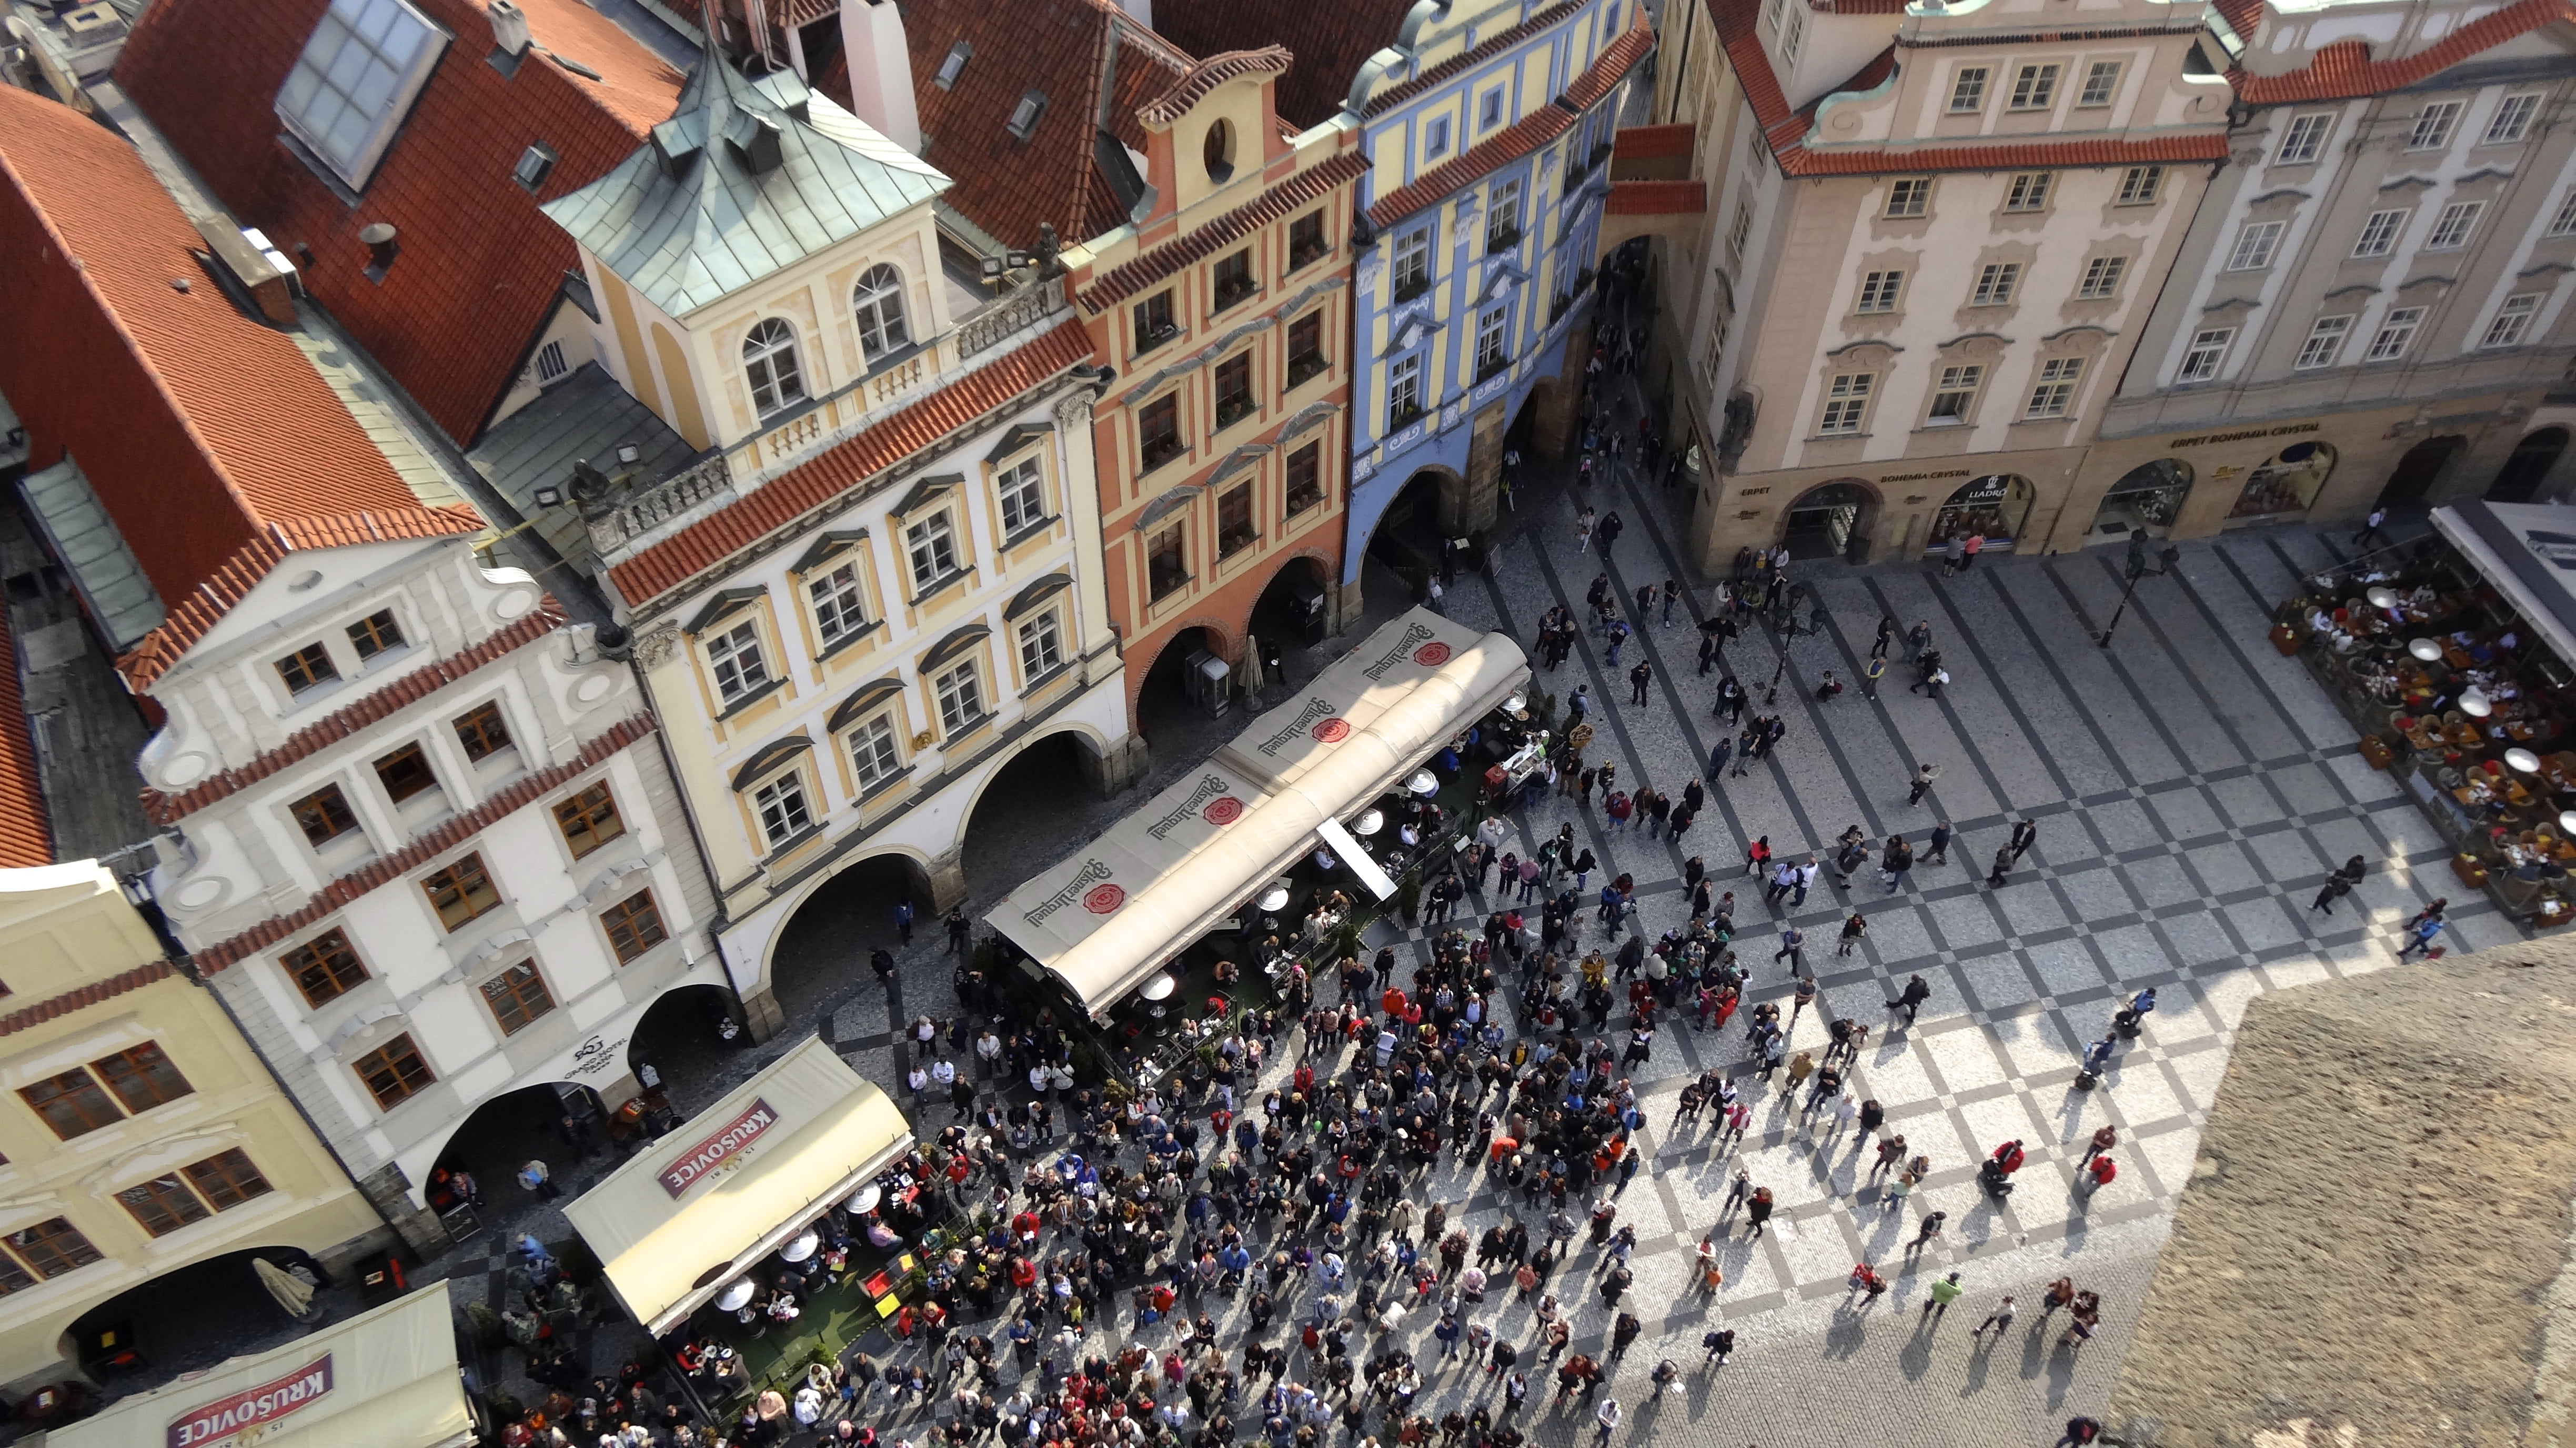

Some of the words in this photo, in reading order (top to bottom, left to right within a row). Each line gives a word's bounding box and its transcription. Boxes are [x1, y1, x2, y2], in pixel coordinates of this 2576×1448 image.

[2171, 436, 2208, 449] ERPET
[2210, 429, 2267, 444] BOHEMIA
[2271, 423, 2319, 436] CRYSTAL
[1742, 486, 1770, 496] ERPET
[1881, 472, 1927, 483] BOHEMIA
[1930, 470, 1970, 479] CRYSTAL
[1397, 622, 1435, 656] Pilsner
[1366, 653, 1407, 681] Urquell
[1295, 697, 1336, 730] Pilsner
[1261, 729, 1305, 757] Urquell
[1187, 773, 1229, 811] Pilsner
[1150, 808, 1197, 841] Urquell
[1067, 858, 1113, 898] Pilsner
[1027, 893, 1076, 928] Urquell
[565, 1058, 597, 1079] GRAND
[599, 1038, 627, 1058] HOTEL
[667, 1109, 771, 1188] KRUŠOVICE
[745, 1147, 755, 1155] 15
[711, 1171, 721, 1180] 81
[178, 1371, 324, 1446] KRUŠOVICE
